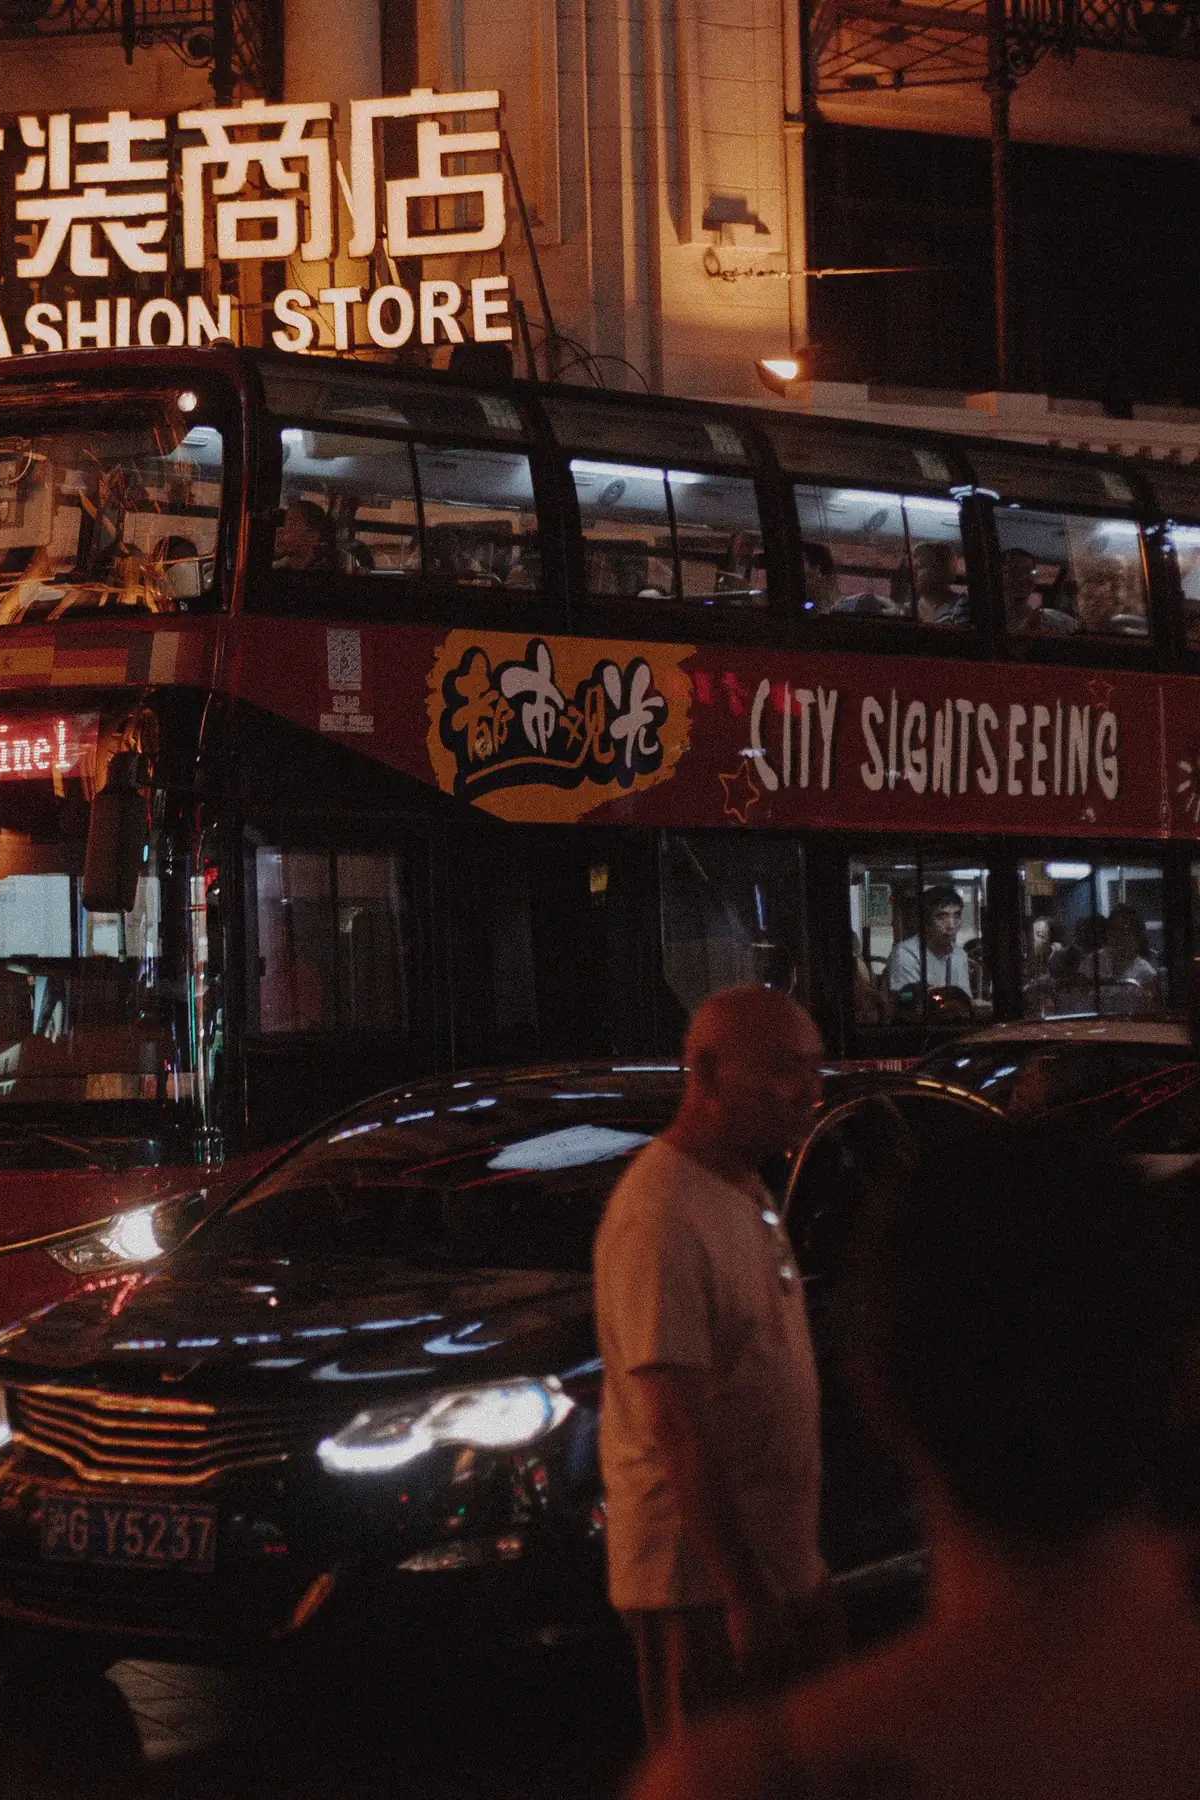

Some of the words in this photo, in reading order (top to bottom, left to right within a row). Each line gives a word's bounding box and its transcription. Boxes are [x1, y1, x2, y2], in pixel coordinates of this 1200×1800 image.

[271, 275, 513, 354] STORE
[452, 643, 666, 768] 都市观光
[750, 678, 838, 792] CITY
[860, 688, 1119, 800] SIGHTSEEING
